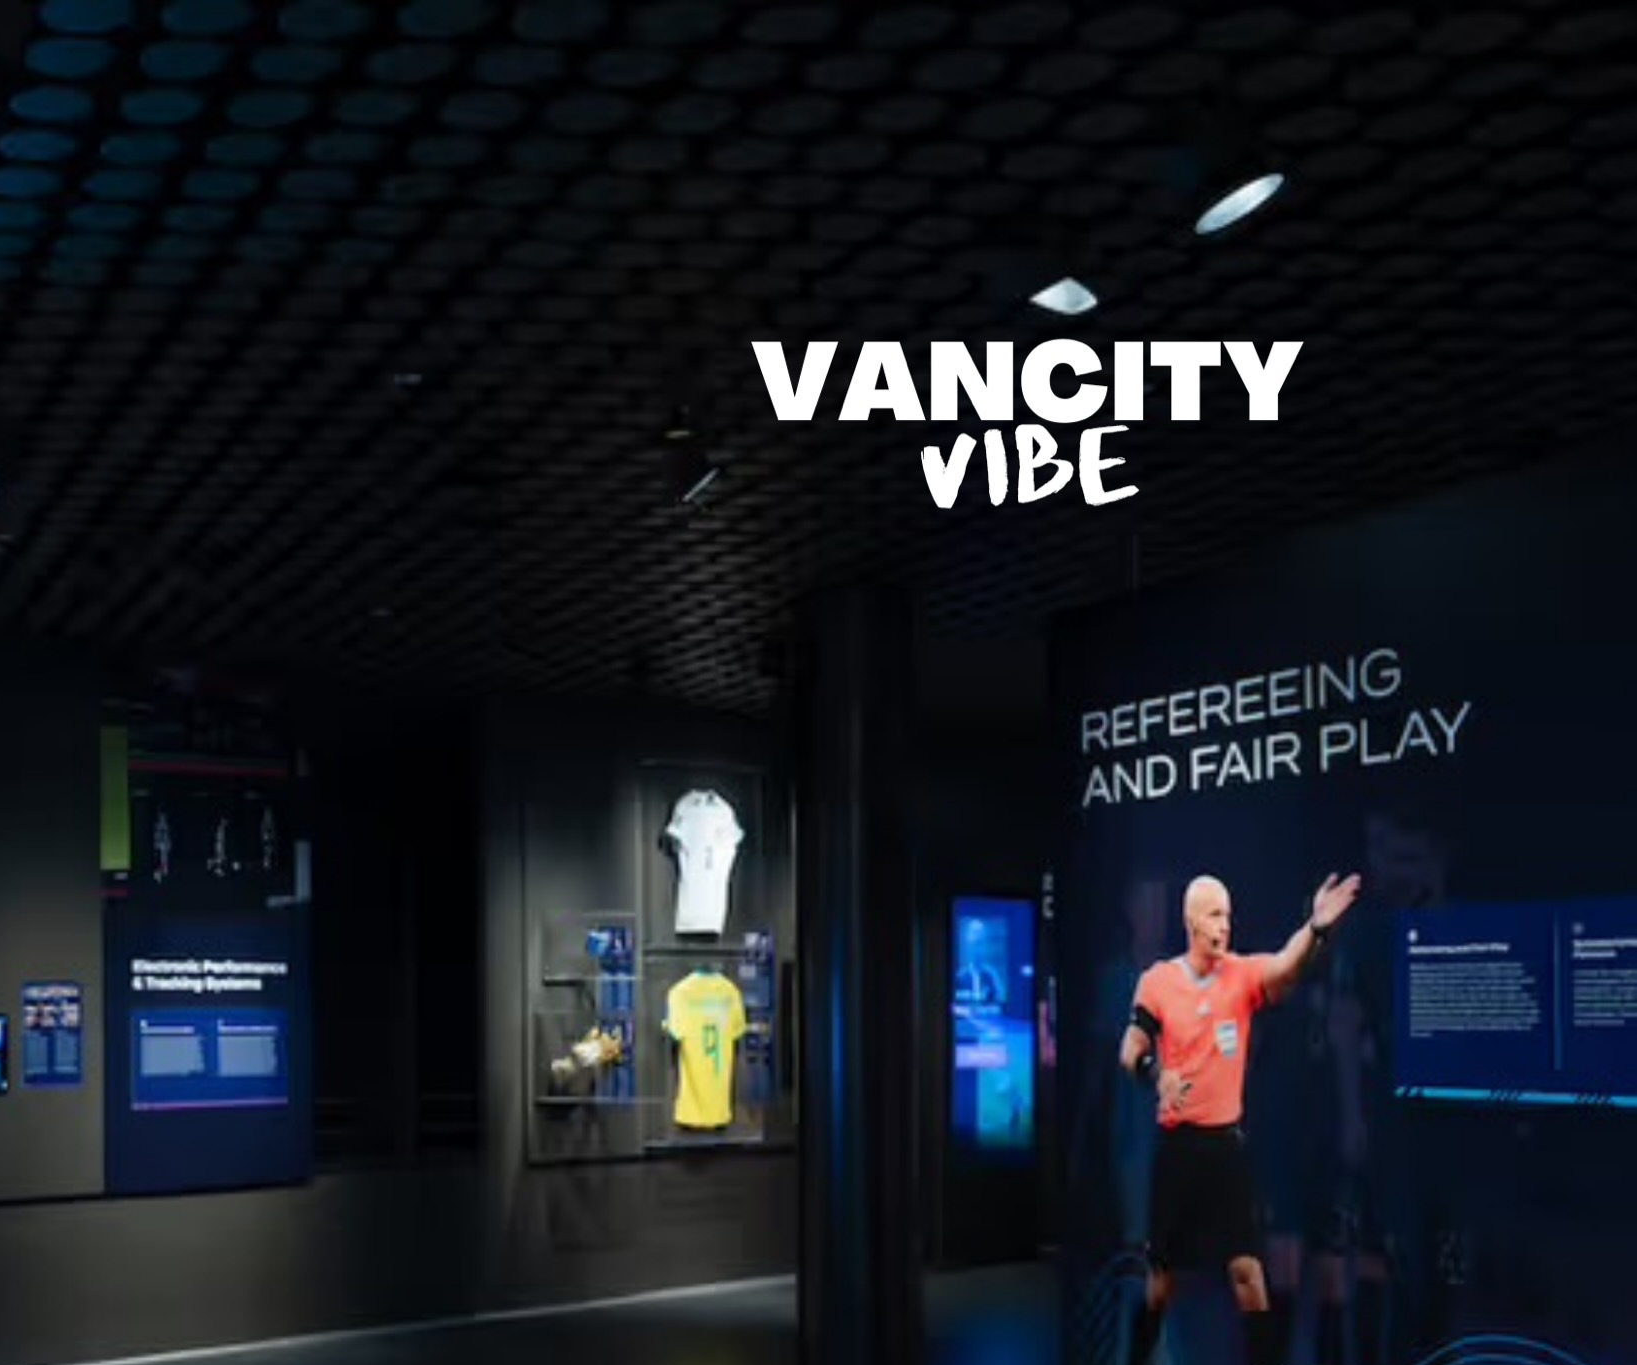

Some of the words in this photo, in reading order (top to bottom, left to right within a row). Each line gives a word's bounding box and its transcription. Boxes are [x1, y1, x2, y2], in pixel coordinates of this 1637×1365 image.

[1082, 648, 1403, 753] REFEREEING
[1083, 754, 1177, 808] AND
[1189, 731, 1301, 792] FAIR
[1318, 701, 1473, 773] PLAY
[132, 958, 200, 974] Electronic
[203, 959, 288, 975] Performance
[145, 976, 204, 993] Tracking
[206, 976, 262, 993] Systems
